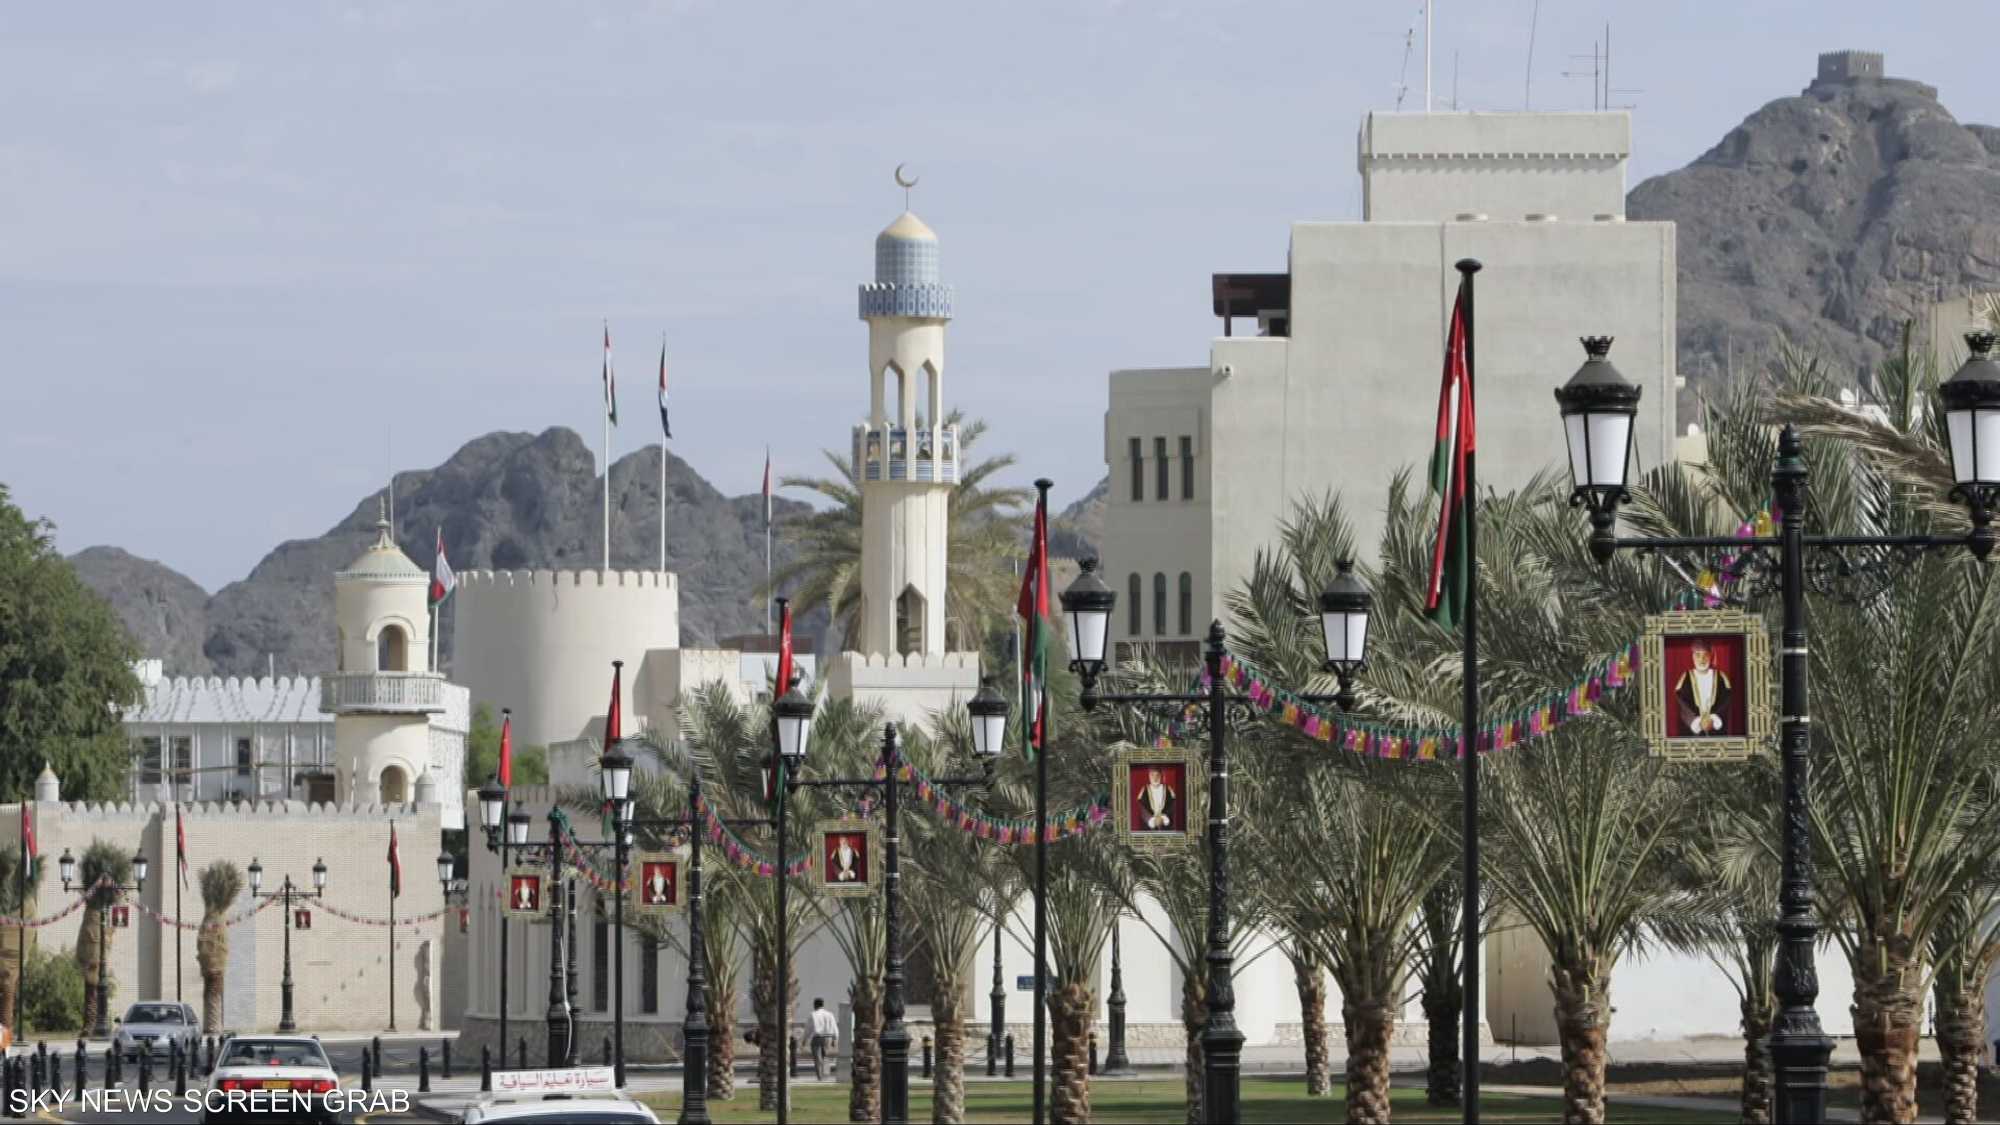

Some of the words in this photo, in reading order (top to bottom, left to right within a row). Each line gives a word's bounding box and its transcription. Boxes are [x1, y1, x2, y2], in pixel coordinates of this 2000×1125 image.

[500, 1072, 543, 1091] السياقة
[544, 1072, 573, 1089] تعليم
[575, 1071, 609, 1089] سيارة
